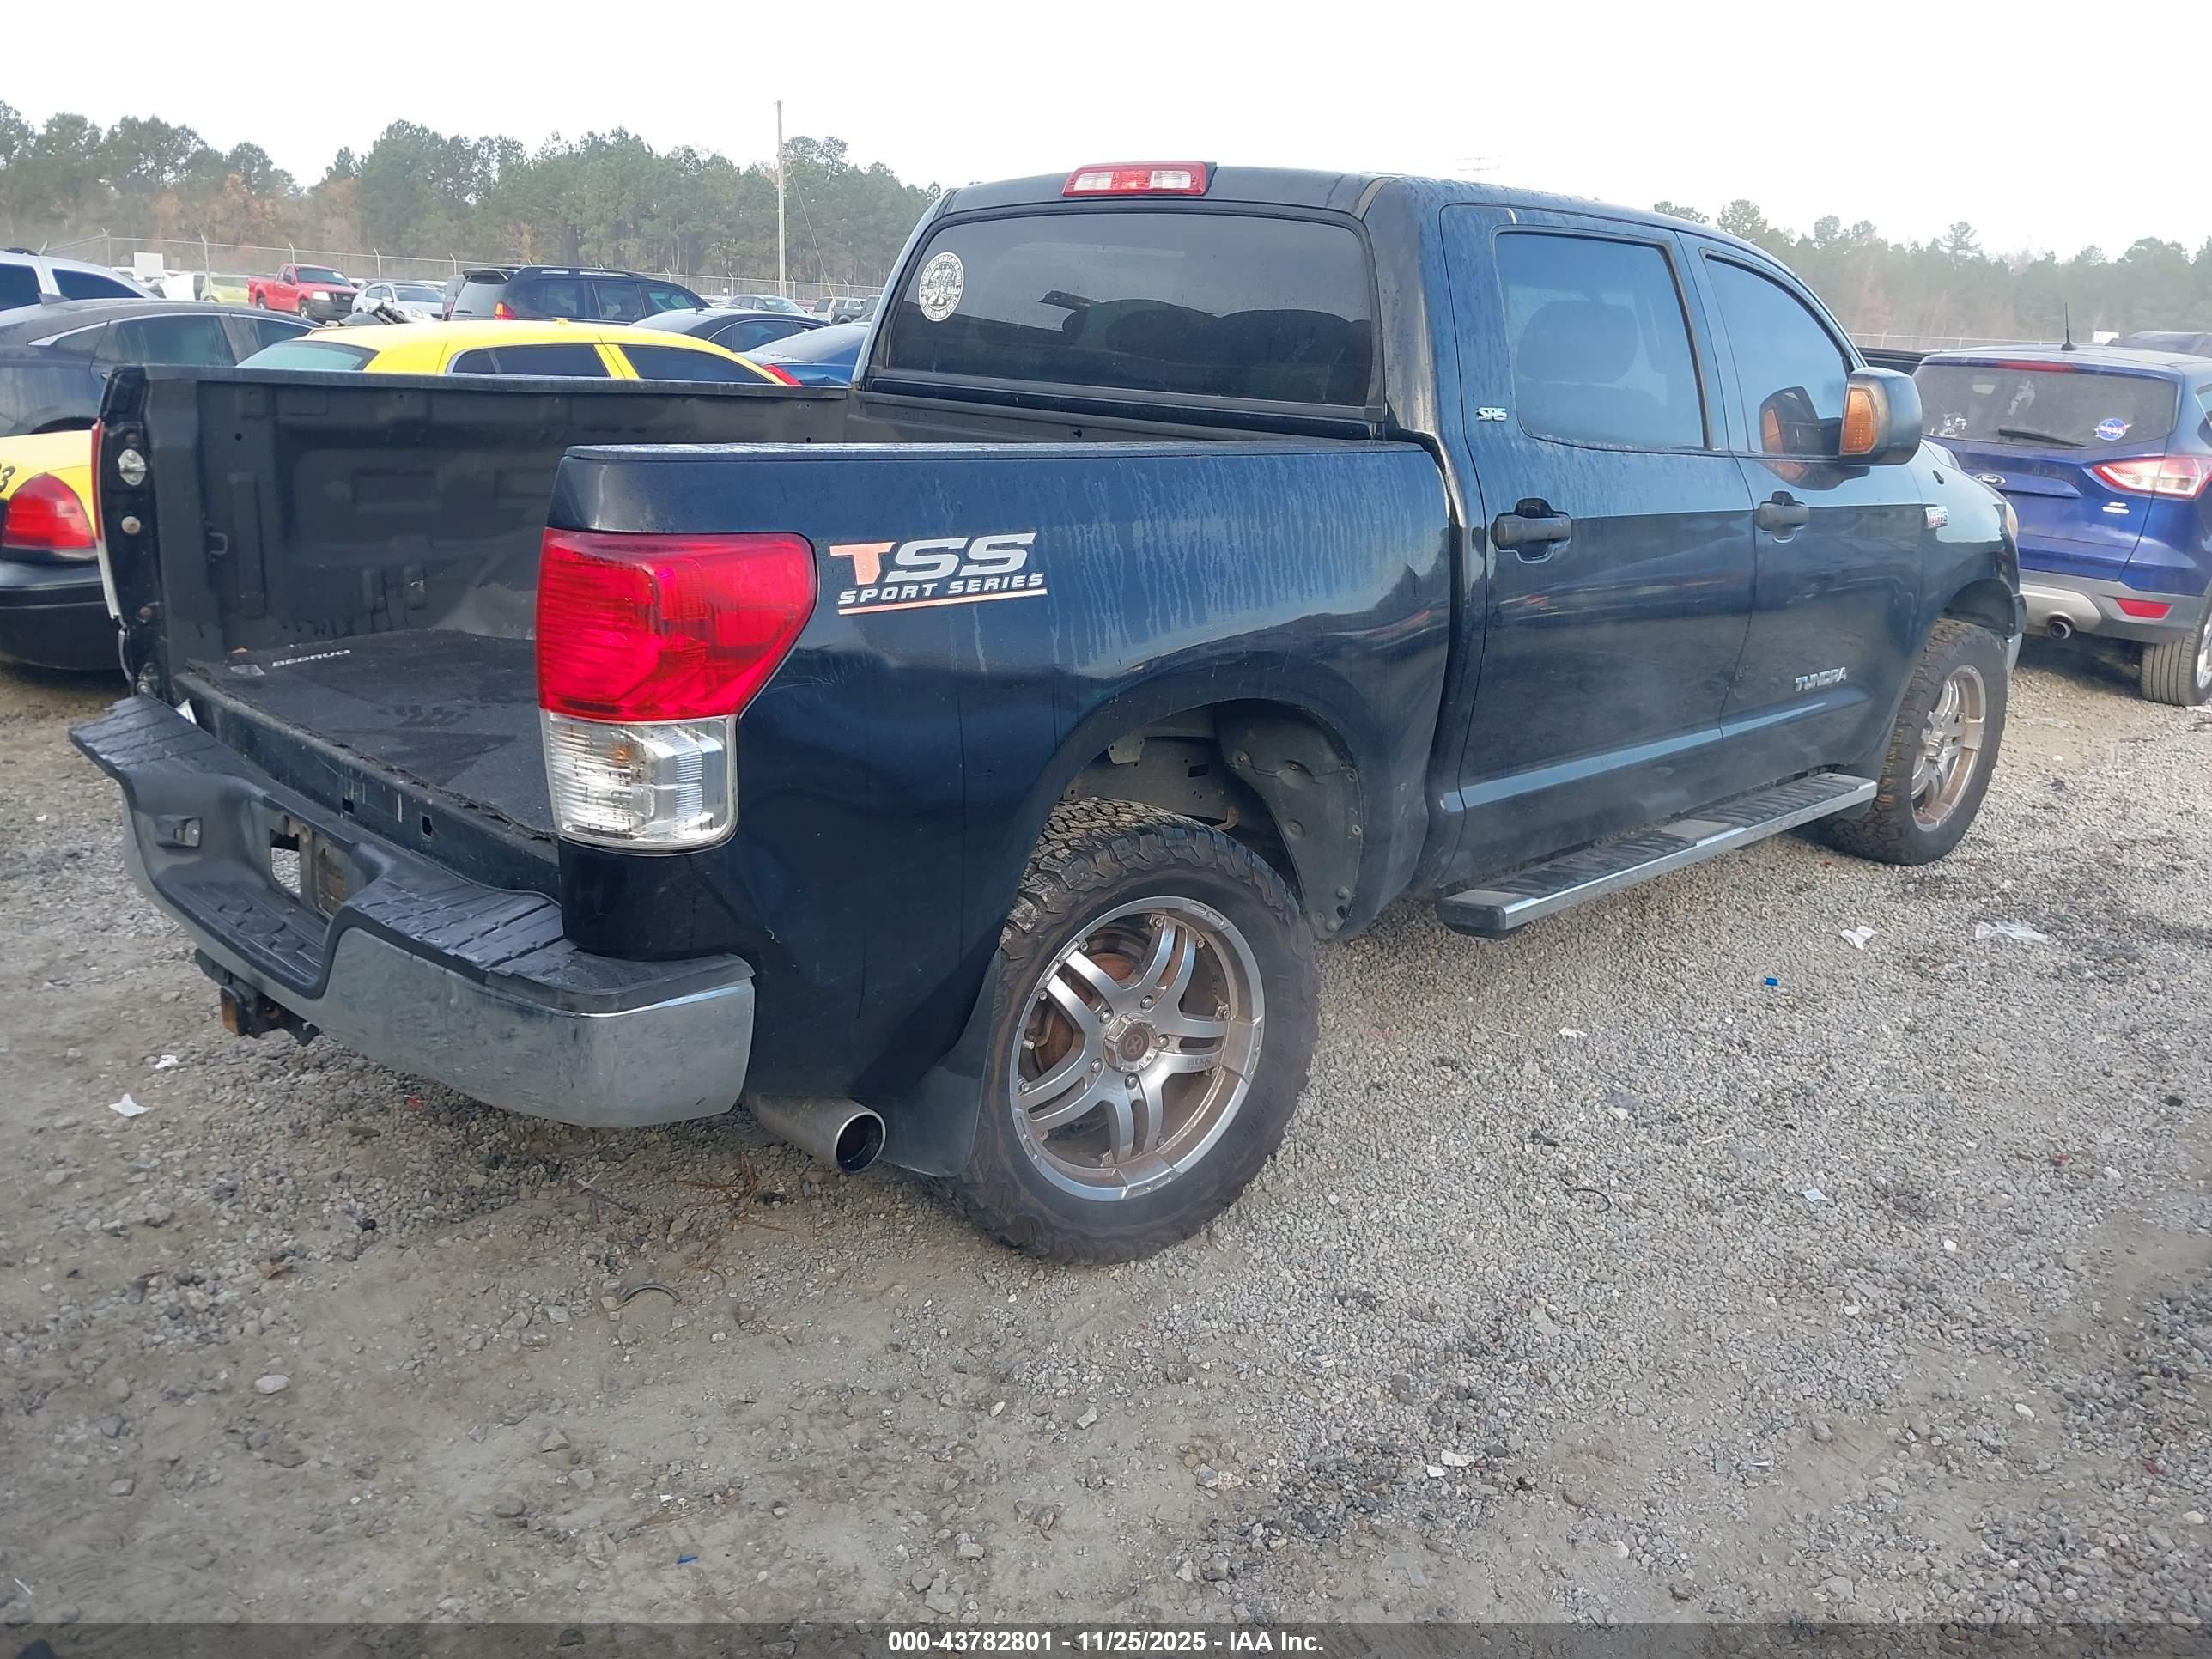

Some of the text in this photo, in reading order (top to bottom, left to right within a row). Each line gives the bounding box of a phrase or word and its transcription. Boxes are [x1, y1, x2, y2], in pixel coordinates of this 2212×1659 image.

[830, 532, 1037, 586] TSS
[837, 573, 1045, 605] SPORT SERIES
[1794, 666, 1847, 692] TUNDRA
